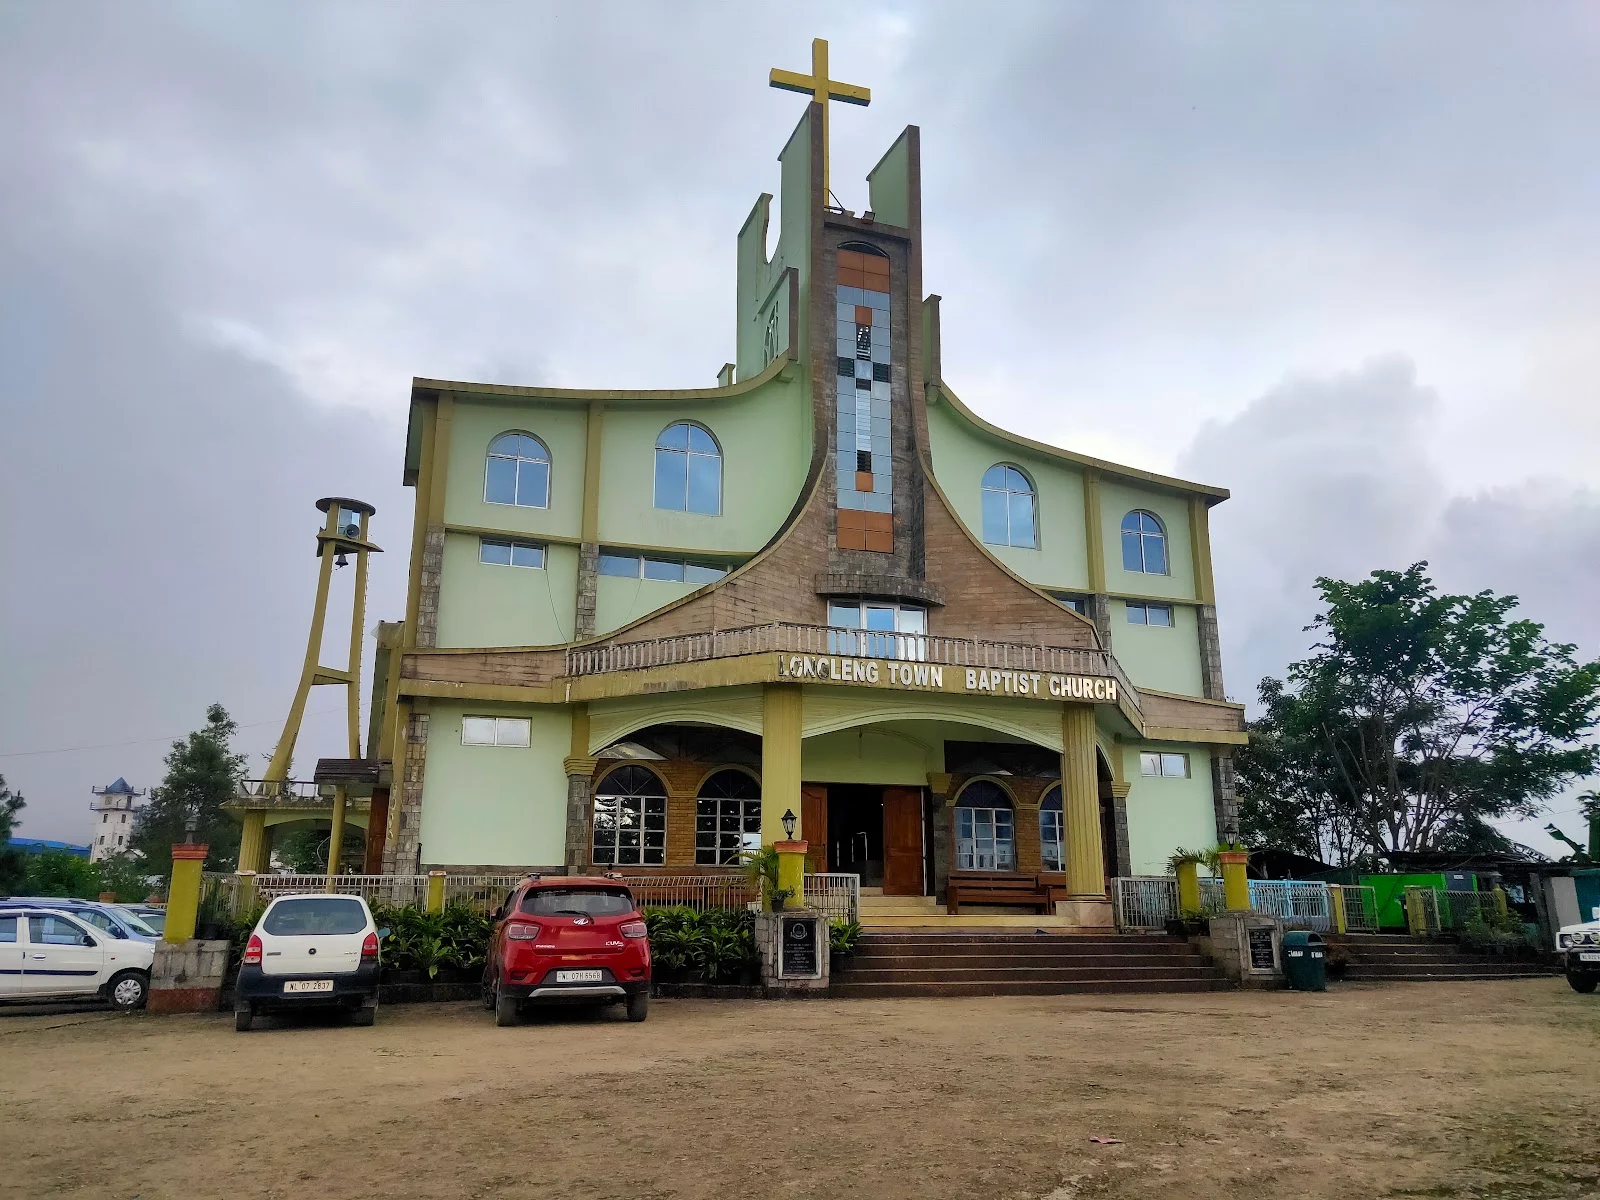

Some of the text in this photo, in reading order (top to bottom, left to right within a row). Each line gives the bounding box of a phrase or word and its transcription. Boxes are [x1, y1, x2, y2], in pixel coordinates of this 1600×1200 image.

[887, 662, 943, 688] TOWN
[965, 669, 1040, 694] BAPTIST
[1049, 675, 1117, 700] CHURCH
[289, 982, 330, 991] NL 07 2837
